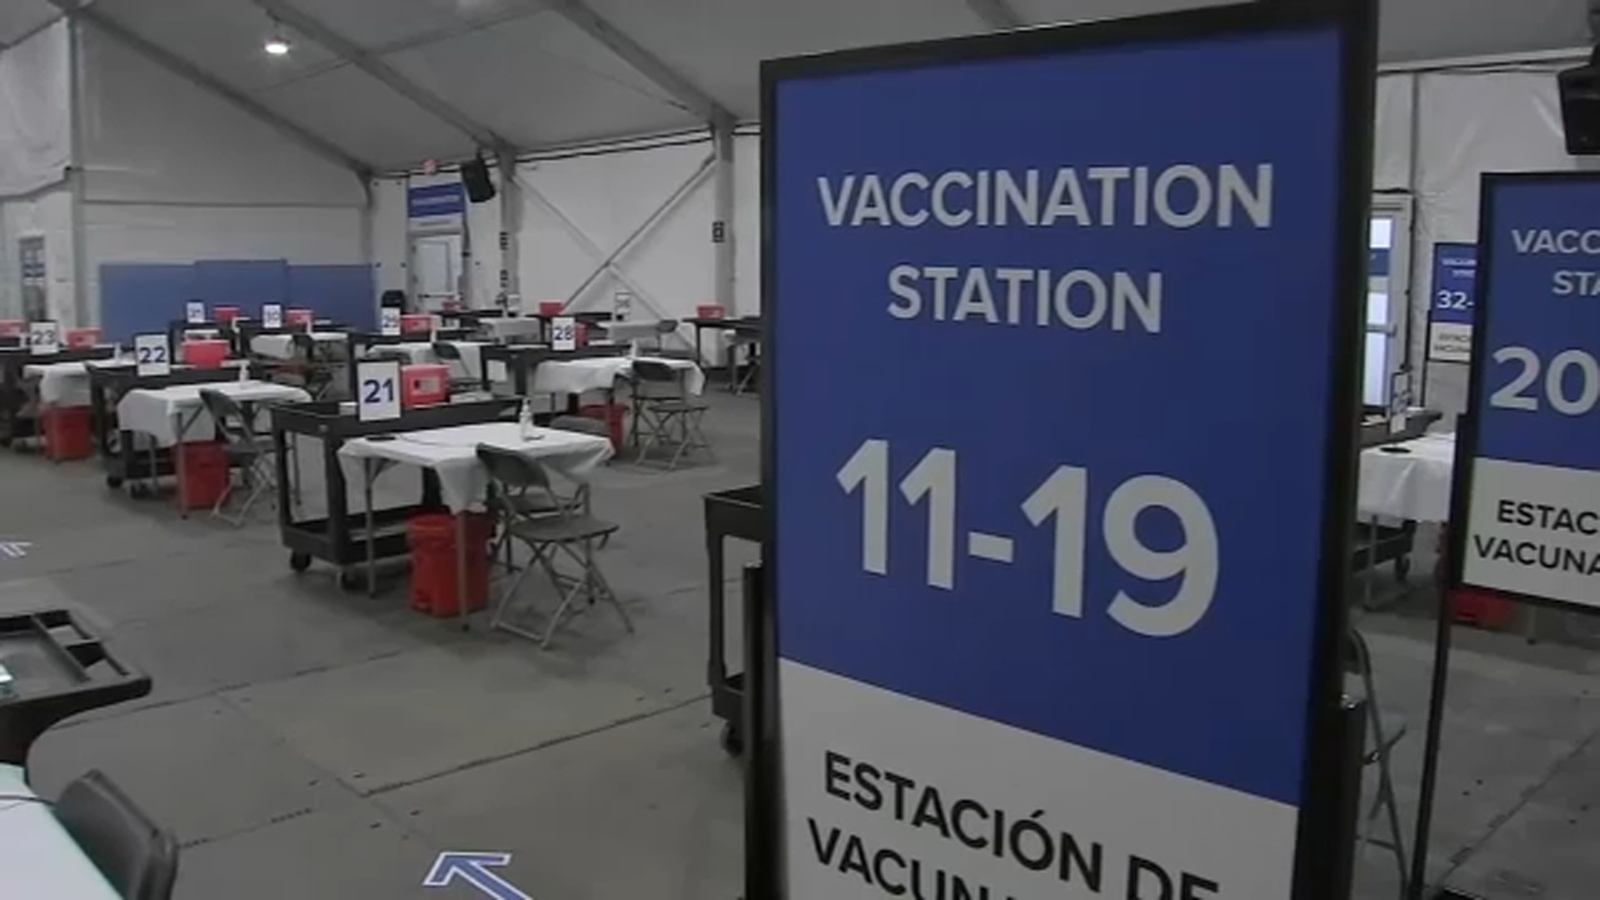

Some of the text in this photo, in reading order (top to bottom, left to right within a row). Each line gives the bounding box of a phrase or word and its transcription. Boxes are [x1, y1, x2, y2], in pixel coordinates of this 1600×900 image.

[816, 162, 1274, 229] VACCINATION
[886, 264, 1163, 334] STATION
[139, 346, 167, 365] 22
[363, 378, 394, 405] 21
[836, 438, 1220, 638] 11-19
[824, 750, 1103, 894] ESTACIÓN
